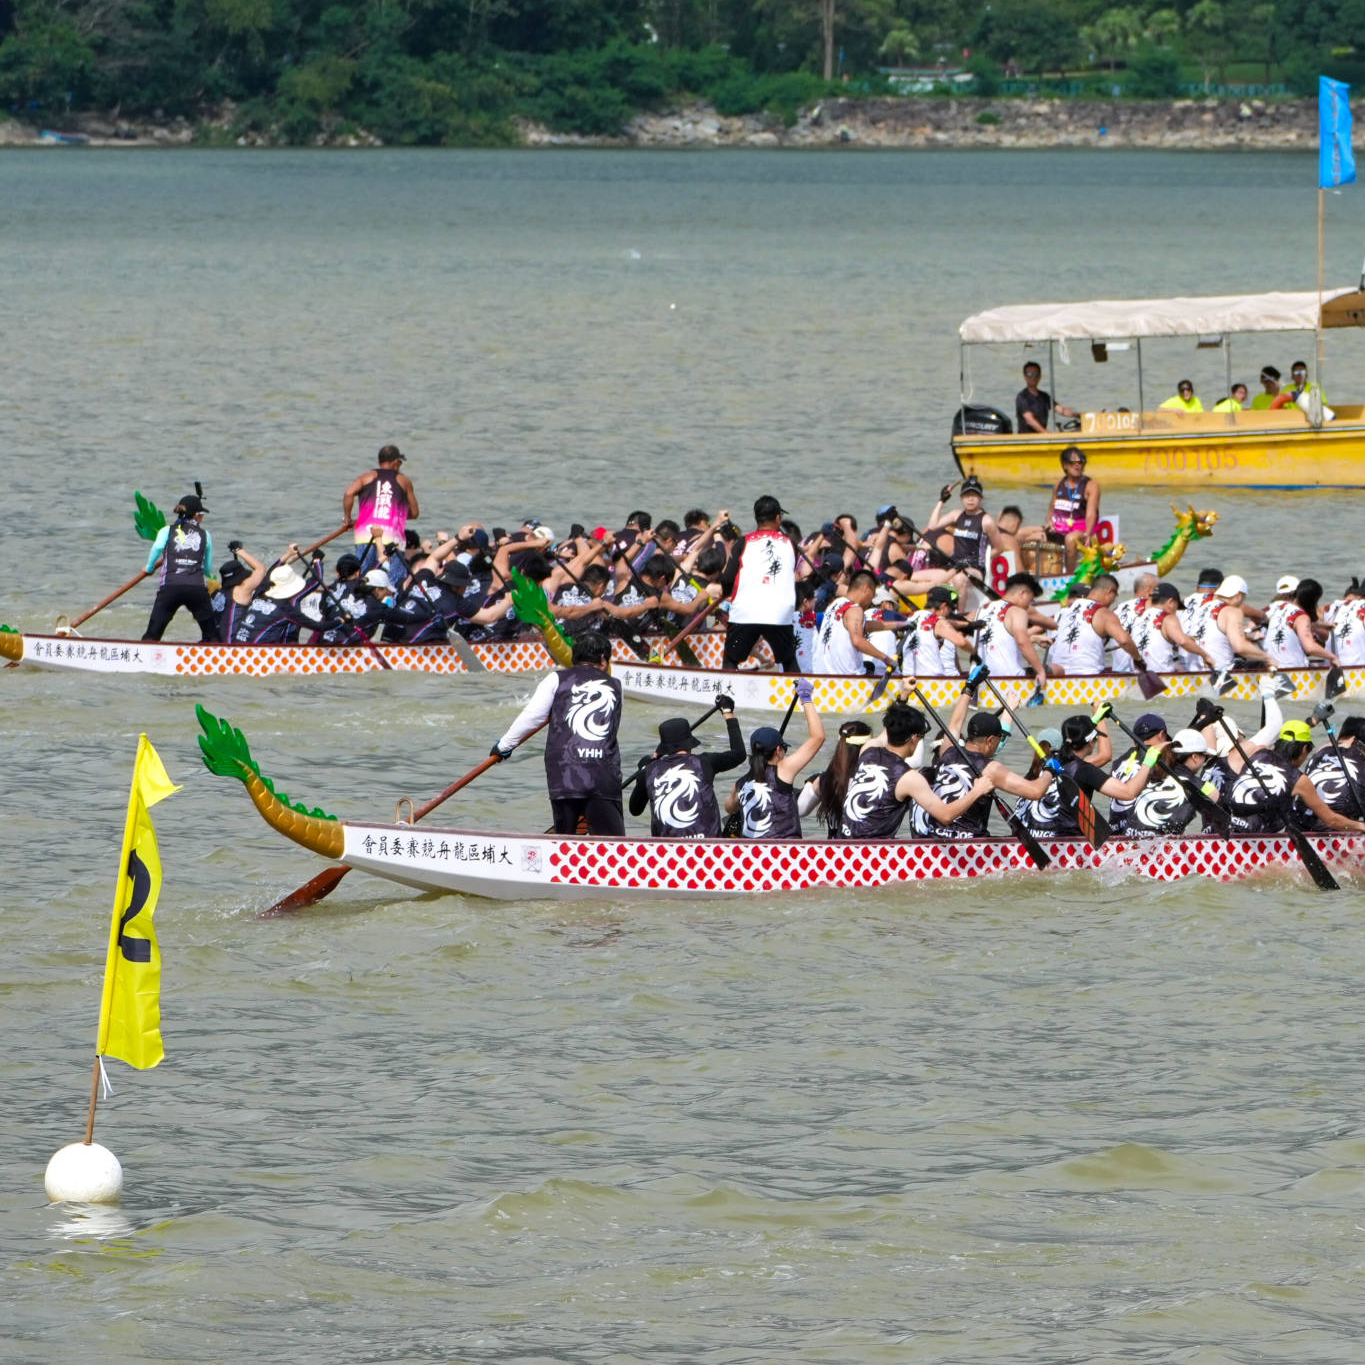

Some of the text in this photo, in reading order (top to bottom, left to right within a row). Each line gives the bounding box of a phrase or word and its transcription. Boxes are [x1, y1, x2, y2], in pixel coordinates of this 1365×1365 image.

[1139, 445, 1239, 473] 700105
[991, 555, 1009, 597] 8
[577, 747, 603, 758] YHH
[117, 848, 151, 963] 2
